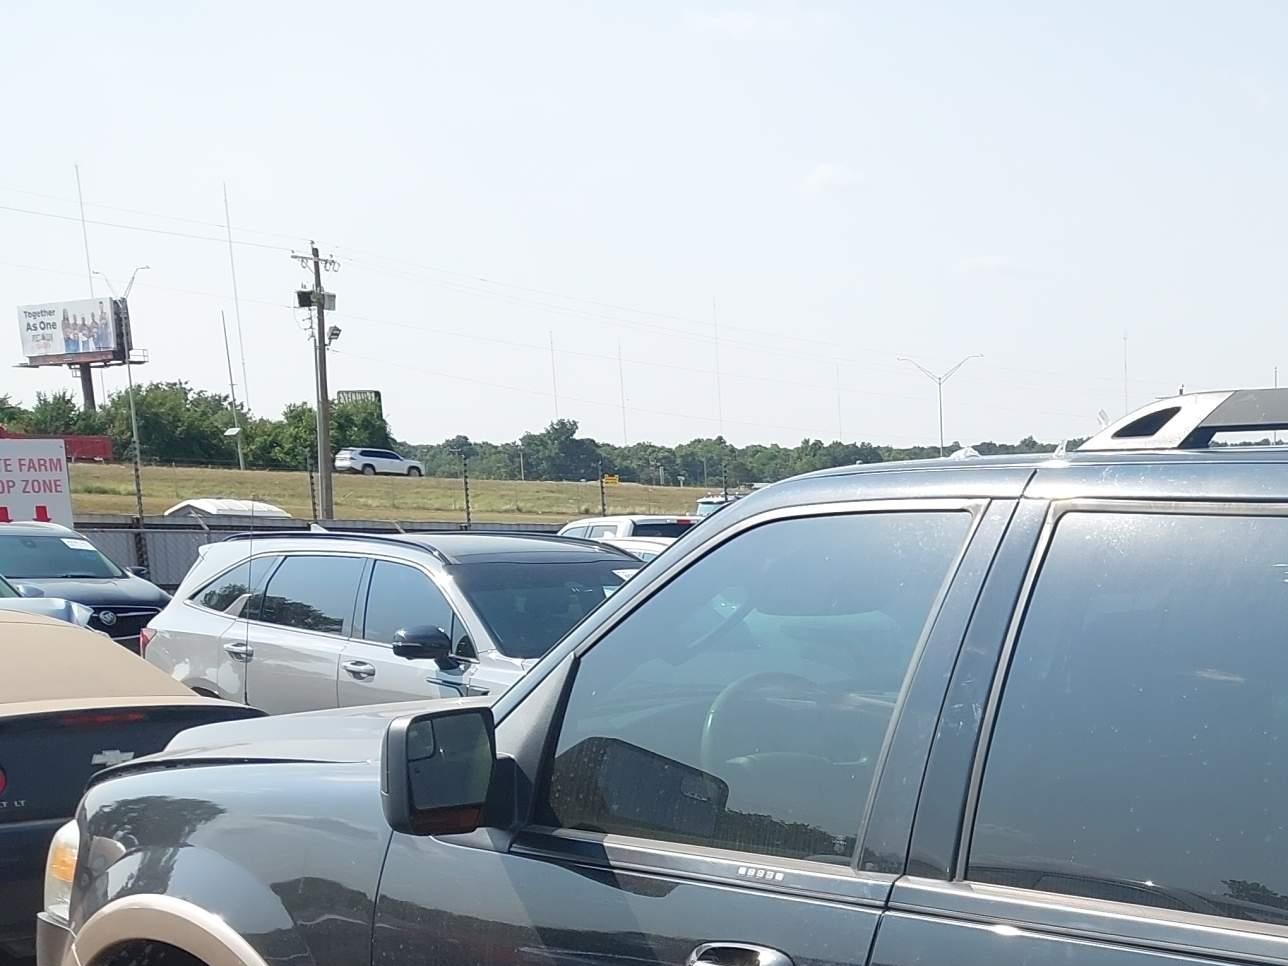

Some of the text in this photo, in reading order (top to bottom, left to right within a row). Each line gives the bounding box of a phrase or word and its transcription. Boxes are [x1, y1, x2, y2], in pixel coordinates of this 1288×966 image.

[23, 310, 55, 319] Together
[26, 321, 57, 332] As One
[18, 458, 63, 472] FARM
[21, 479, 63, 494] ZONE
